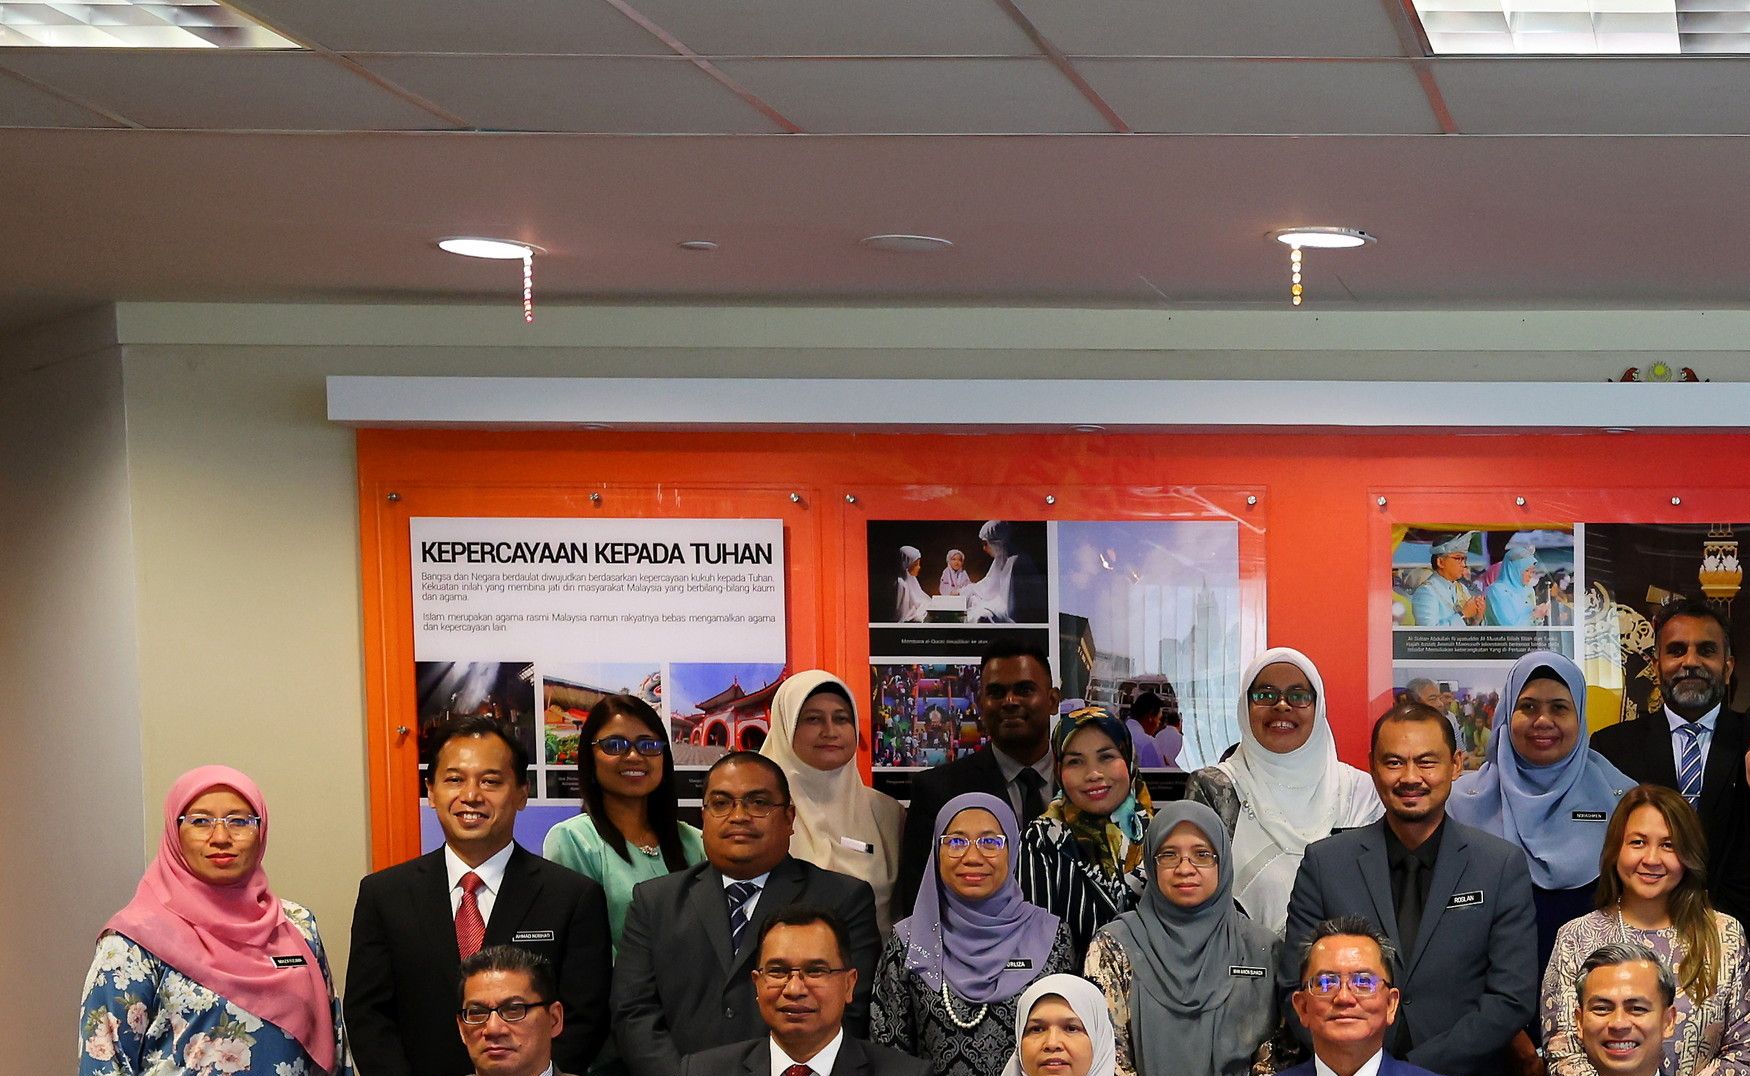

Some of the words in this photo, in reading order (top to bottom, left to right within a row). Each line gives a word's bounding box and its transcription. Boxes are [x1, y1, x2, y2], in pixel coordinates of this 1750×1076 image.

[421, 541, 588, 564] KEPERCAYAAN
[594, 542, 686, 564] KEPADA
[689, 542, 773, 565] TUHAN
[421, 572, 451, 583] Bangsa
[453, 572, 469, 582] dan
[471, 572, 500, 583] Negara
[502, 572, 539, 582] berdaulat
[541, 572, 587, 583] diwujudkan
[588, 573, 638, 582] berdasarkan
[639, 573, 689, 584] kepercayaan
[690, 574, 715, 583] kukuh
[717, 574, 746, 584] kepada
[421, 582, 459, 591] Kekuatan
[485, 584, 505, 593] yang
[577, 583, 624, 594] masyarakat
[626, 583, 662, 594] Malaysia
[665, 585, 684, 594] yang
[752, 583, 775, 593] kaum
[421, 592, 438, 601] dan
[422, 613, 445, 622] Islam
[447, 614, 493, 623] merupakan
[495, 615, 524, 624] agama
[526, 614, 549, 622] rasmi
[551, 614, 587, 624] Malaysia
[621, 614, 659, 624] rakyatnya
[661, 614, 686, 622] bebas
[688, 614, 745, 624] mengamalkan
[748, 615, 776, 624] agama
[423, 623, 438, 631] dan
[440, 623, 490, 633] kepercayaan
[1453, 895, 1475, 904] ROSLAN
